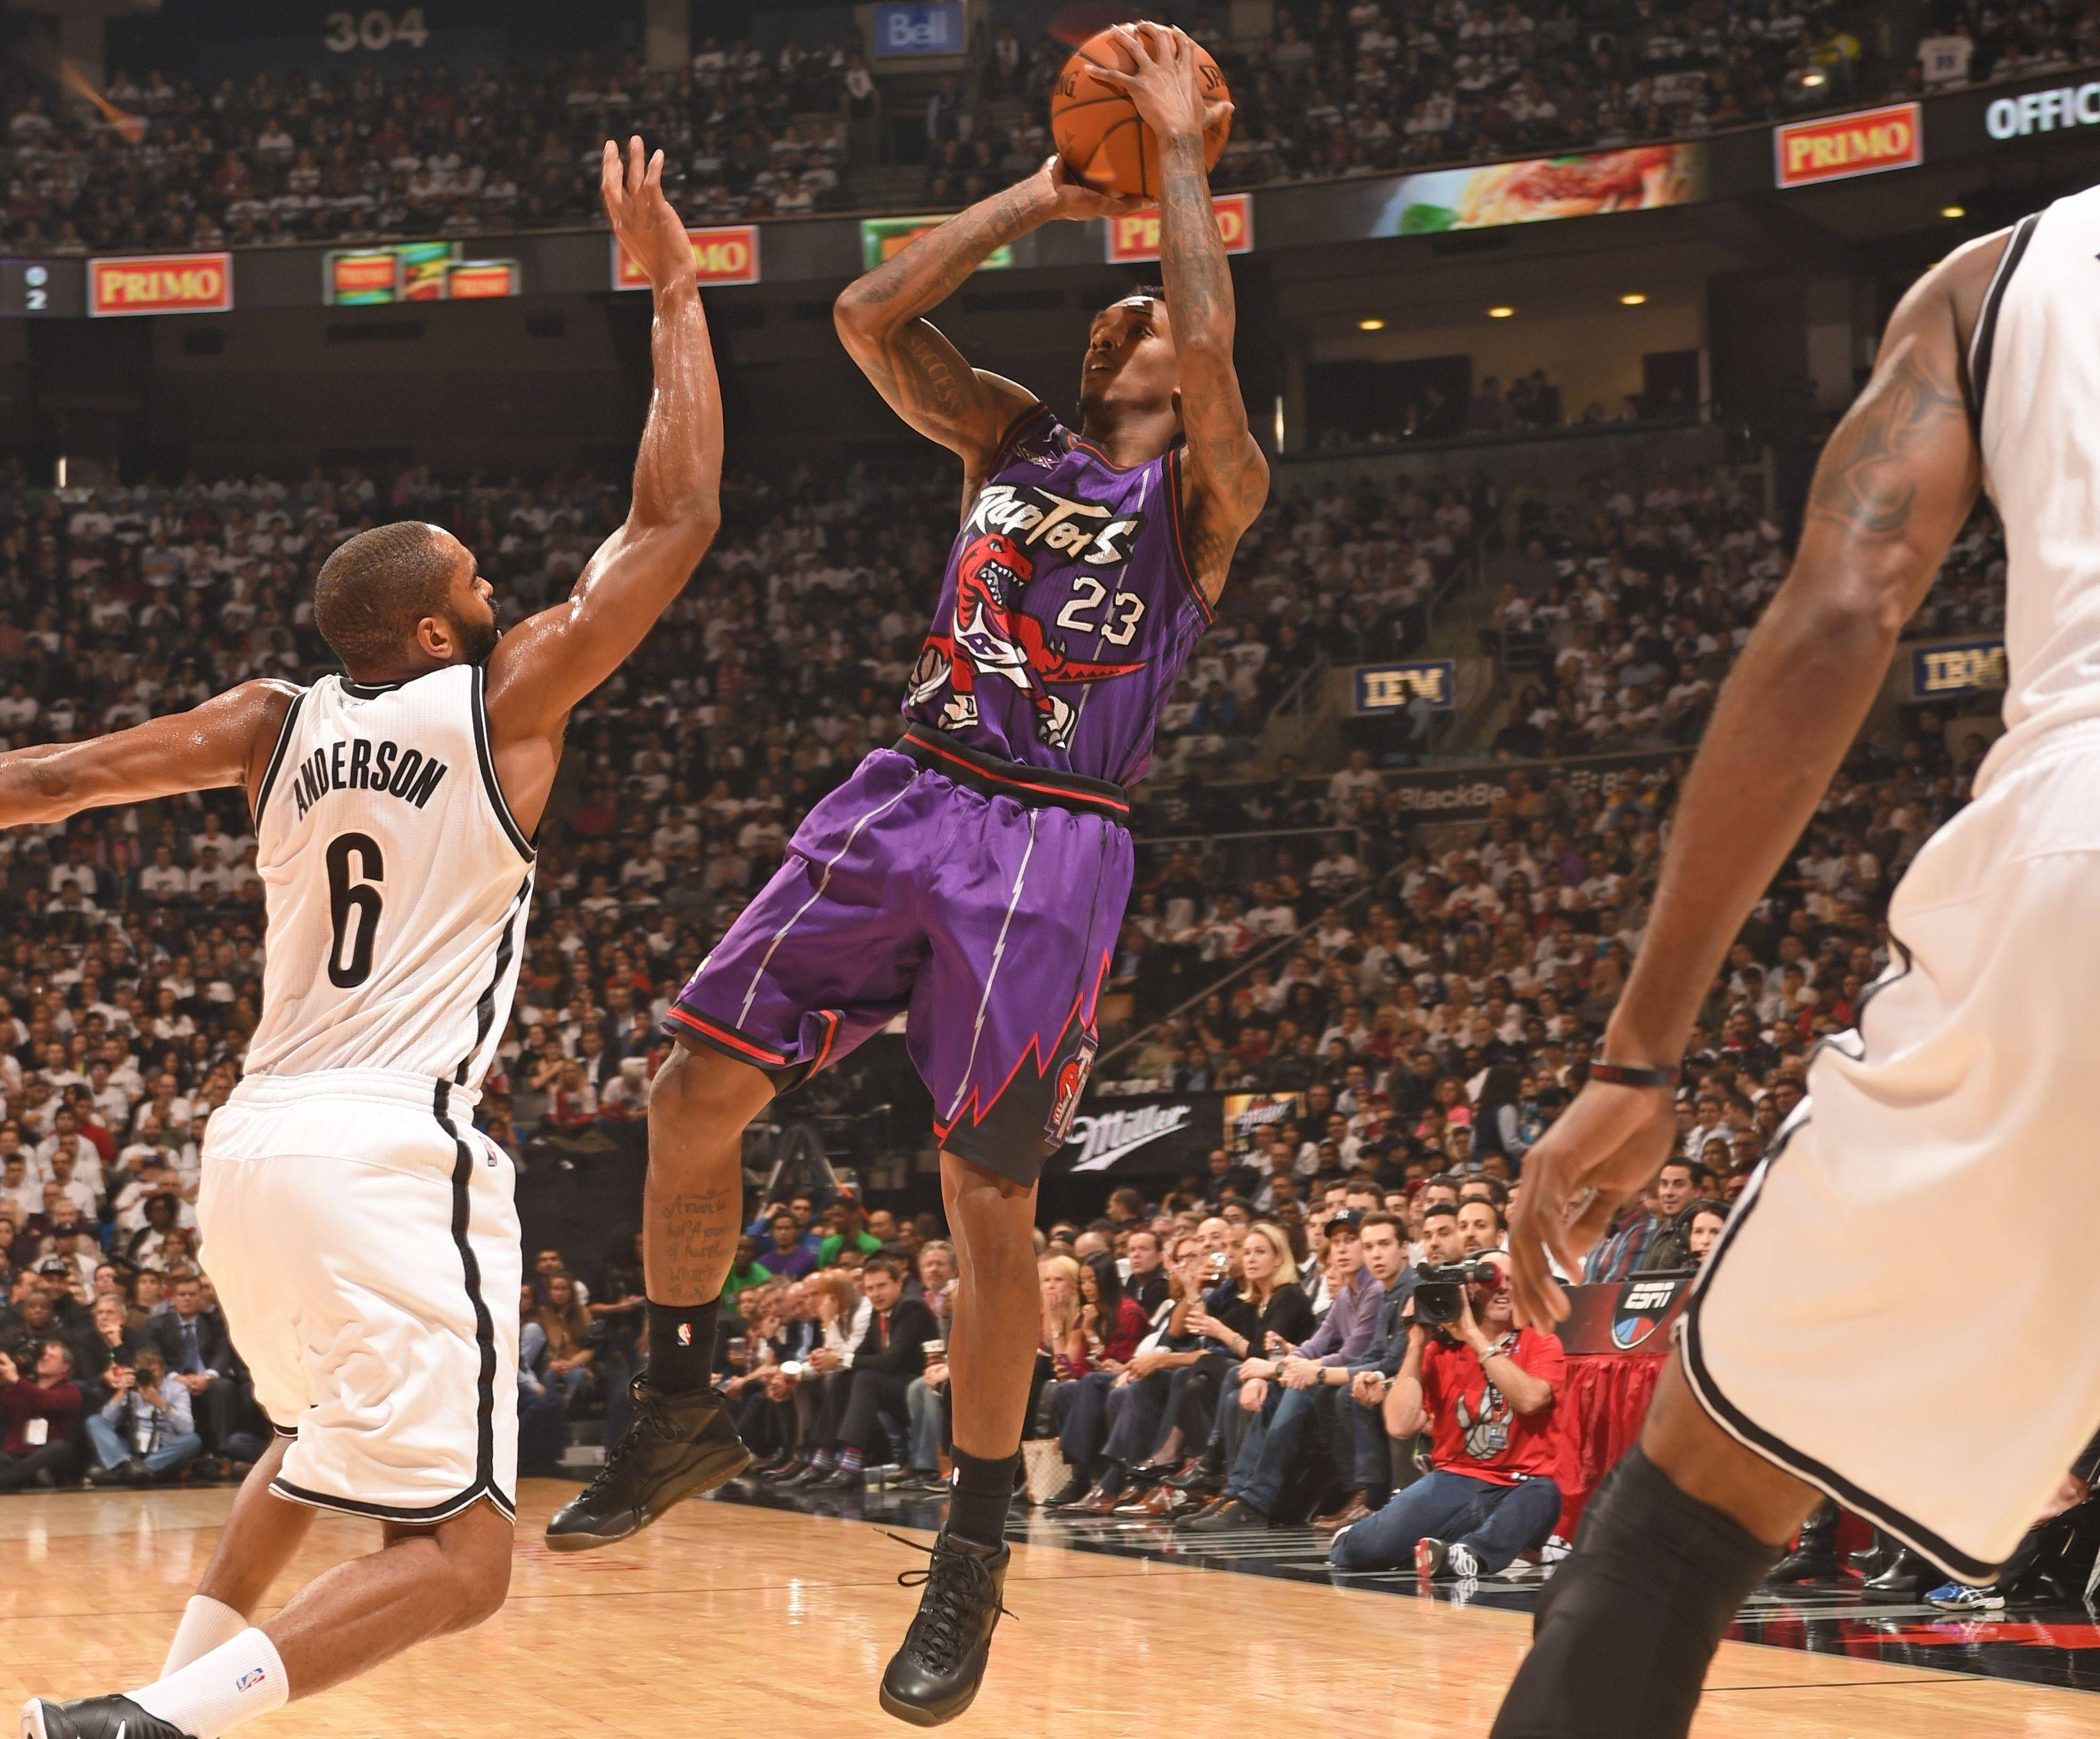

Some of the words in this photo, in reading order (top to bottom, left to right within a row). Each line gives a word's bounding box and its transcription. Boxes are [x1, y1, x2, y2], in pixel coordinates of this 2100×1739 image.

[323, 8, 428, 53] 304
[889, 12, 947, 45] Bell
[1788, 122, 1910, 172] PRIMO
[1120, 211, 1241, 248] PRO
[101, 269, 220, 303] PRIMO
[1056, 577, 1145, 645] 23
[1364, 667, 1444, 708] IBM
[1924, 646, 2004, 691] IBM
[293, 738, 448, 823] ANDERSON
[326, 832, 384, 988] 6
[1066, 1104, 1191, 1163] Miller
[1624, 1282, 1676, 1309] ESPN
